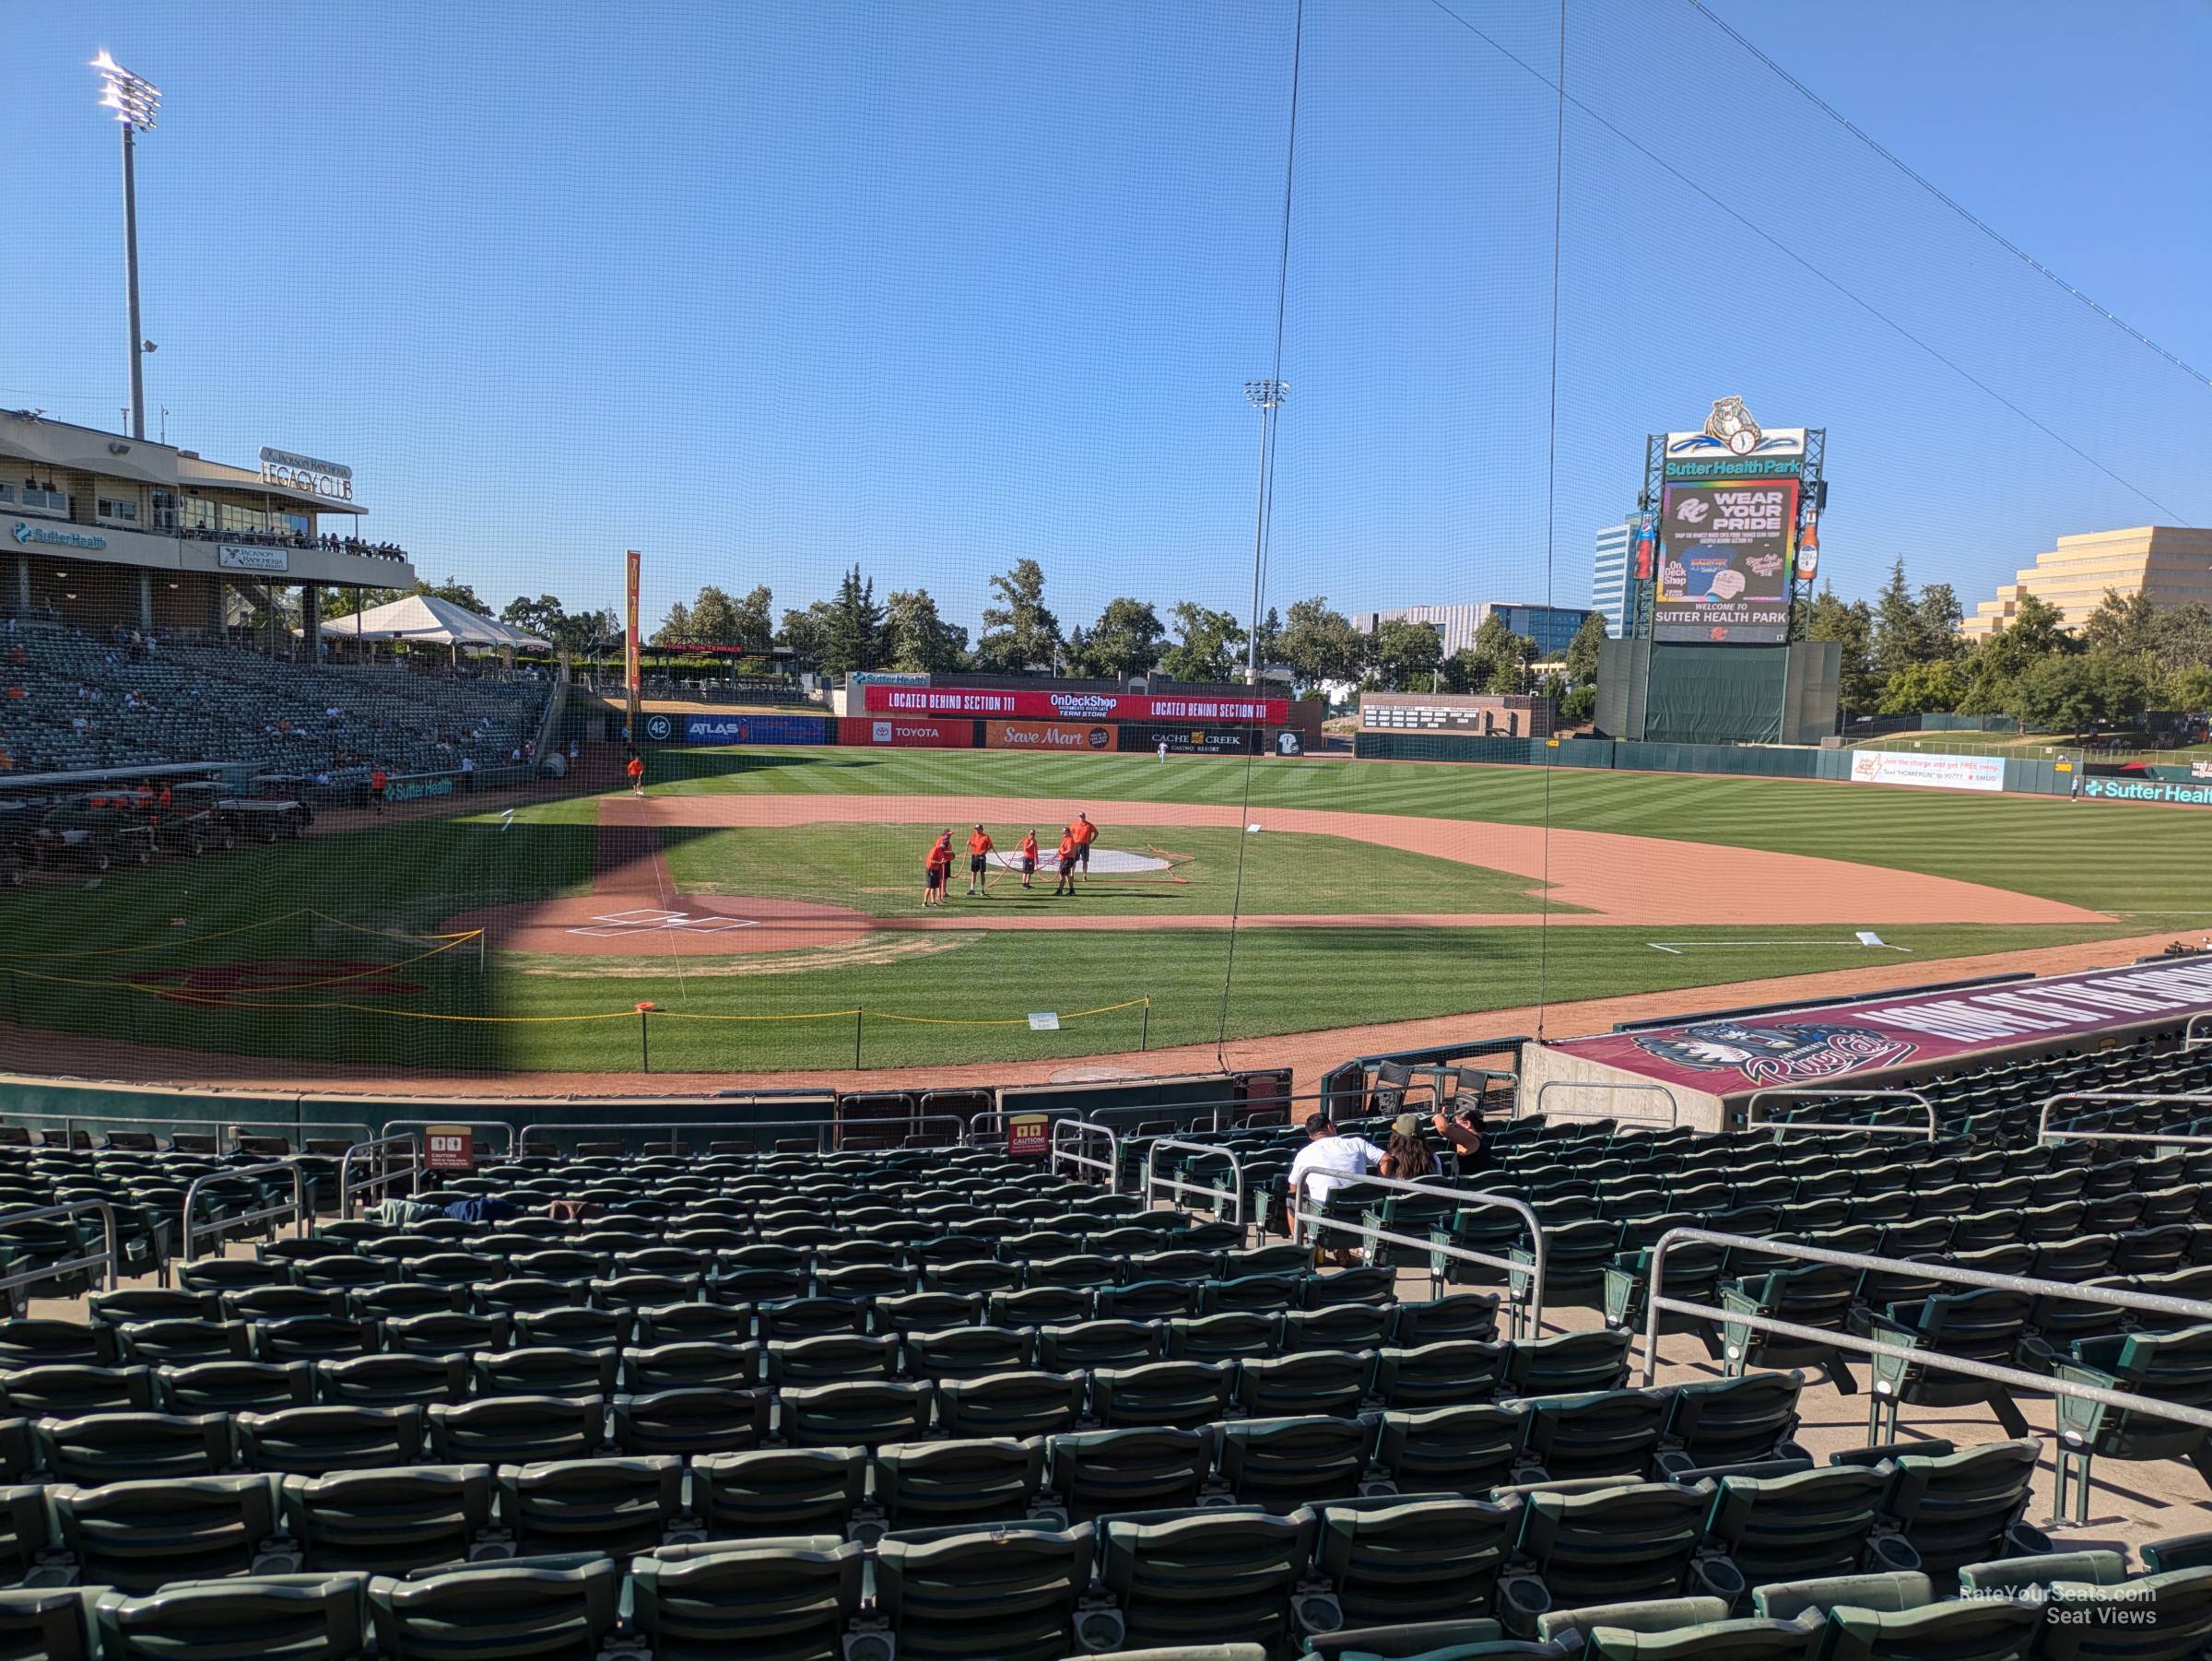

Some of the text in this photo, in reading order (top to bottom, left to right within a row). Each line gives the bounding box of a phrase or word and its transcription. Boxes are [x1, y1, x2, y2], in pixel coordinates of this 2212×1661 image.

[1665, 460, 1800, 476] Sutter Health Park
[262, 462, 353, 501] LEGACY CLUB
[1713, 492, 1783, 504] WEAR
[1719, 505, 1783, 517] YOUR
[1712, 518, 1781, 531] PRIDE
[35, 528, 107, 550] Sutter Health
[1669, 560, 1682, 570] On
[1665, 567, 1687, 576] Deck
[1664, 576, 1687, 586] Shop
[1655, 611, 1786, 623] SUTTER HEALTH PARK
[665, 642, 687, 651] HOME
[706, 644, 742, 653] TERRACE
[866, 675, 926, 686] Sutter Health
[888, 693, 1015, 712] LOCATED BEHIND SECTION 111
[1151, 701, 1266, 718] LOCATED BEHIND SECTION 111
[652, 722, 665, 734] 42
[689, 724, 738, 736] ATLAS
[896, 727, 939, 738] TOYOTA
[1005, 726, 1041, 743] Save
[1041, 728, 1083, 745] Mart
[1152, 734, 1241, 745] CACHE CREEK
[396, 777, 453, 802] Sutter Health
[2105, 782, 2162, 800] Sutter
[2014, 983, 2190, 1014] THE
[1969, 993, 2114, 1022] OF
[1851, 1000, 2072, 1043] HOME
